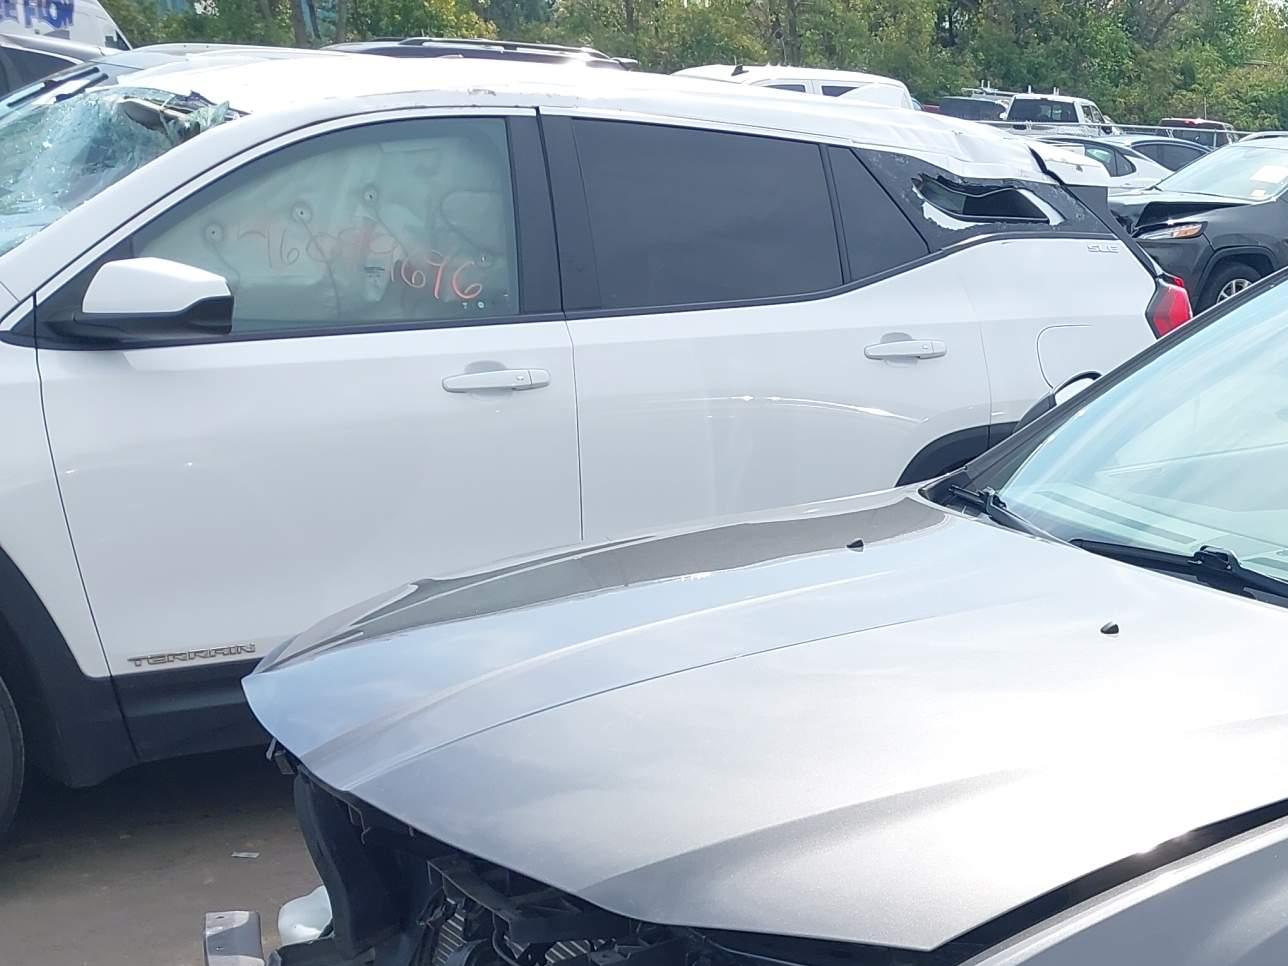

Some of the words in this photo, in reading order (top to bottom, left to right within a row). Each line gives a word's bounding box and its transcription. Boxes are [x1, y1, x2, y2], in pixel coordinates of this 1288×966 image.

[25, 0, 75, 28] FLOW
[1087, 243, 1119, 254] SLE
[127, 643, 256, 667] TERRAIN
